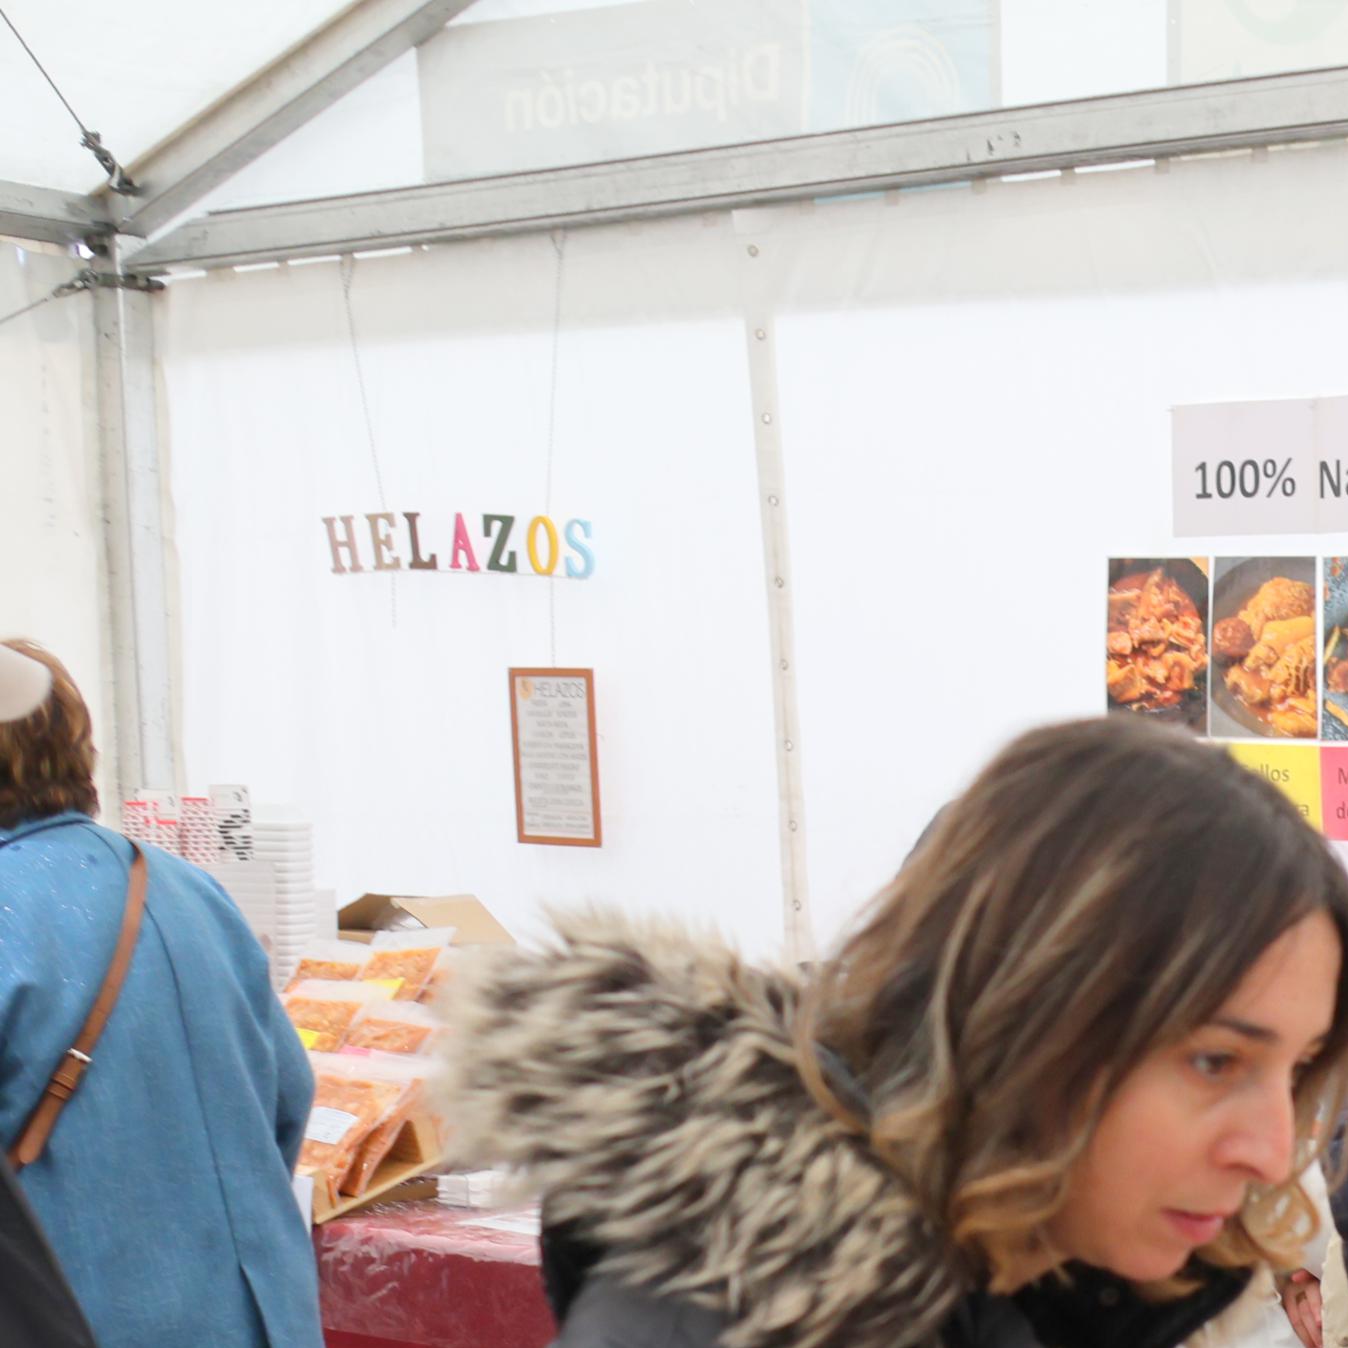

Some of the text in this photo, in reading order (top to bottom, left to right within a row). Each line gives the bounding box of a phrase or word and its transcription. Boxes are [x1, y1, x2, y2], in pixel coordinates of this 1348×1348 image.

[1194, 457, 1297, 501] 100%
[322, 511, 596, 581] HELAZOS
[534, 681, 585, 699] HELAZOS
